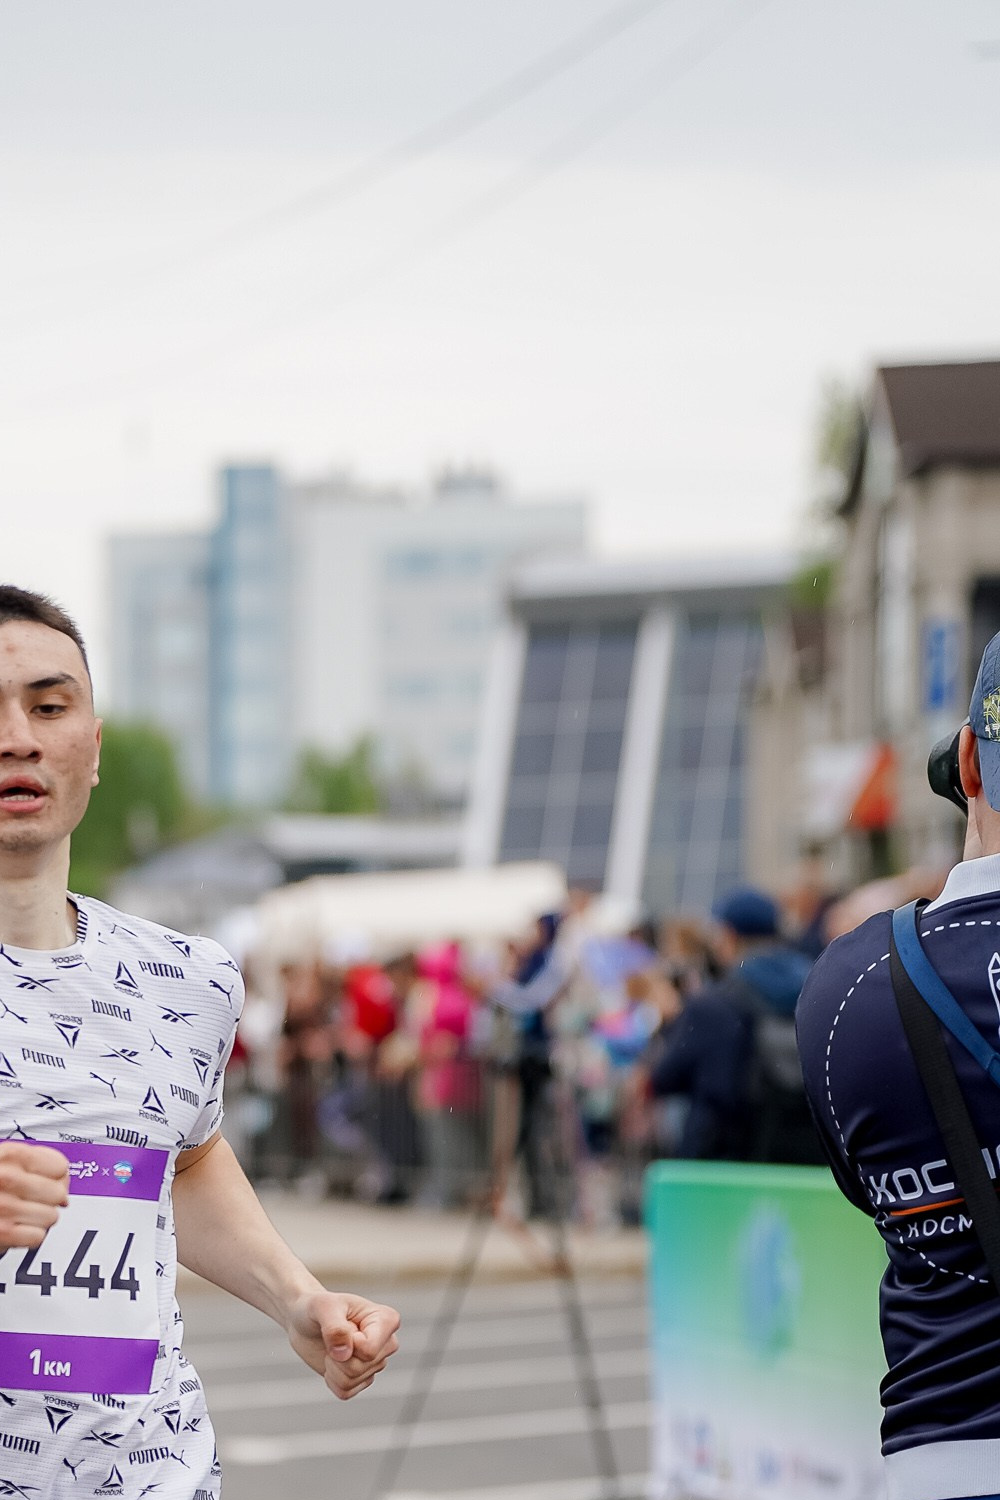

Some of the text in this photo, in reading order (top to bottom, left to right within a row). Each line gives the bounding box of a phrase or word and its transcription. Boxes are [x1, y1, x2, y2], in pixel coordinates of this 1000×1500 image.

[138, 960, 185, 980] PUMA
[91, 999, 132, 1022] PUMA
[21, 1048, 66, 1070] PUMA
[106, 1125, 149, 1148] PUMA
[43, 1394, 80, 1411] Reebok
[128, 1446, 170, 1466] PUMA
[93, 1487, 125, 1497] Reebok
